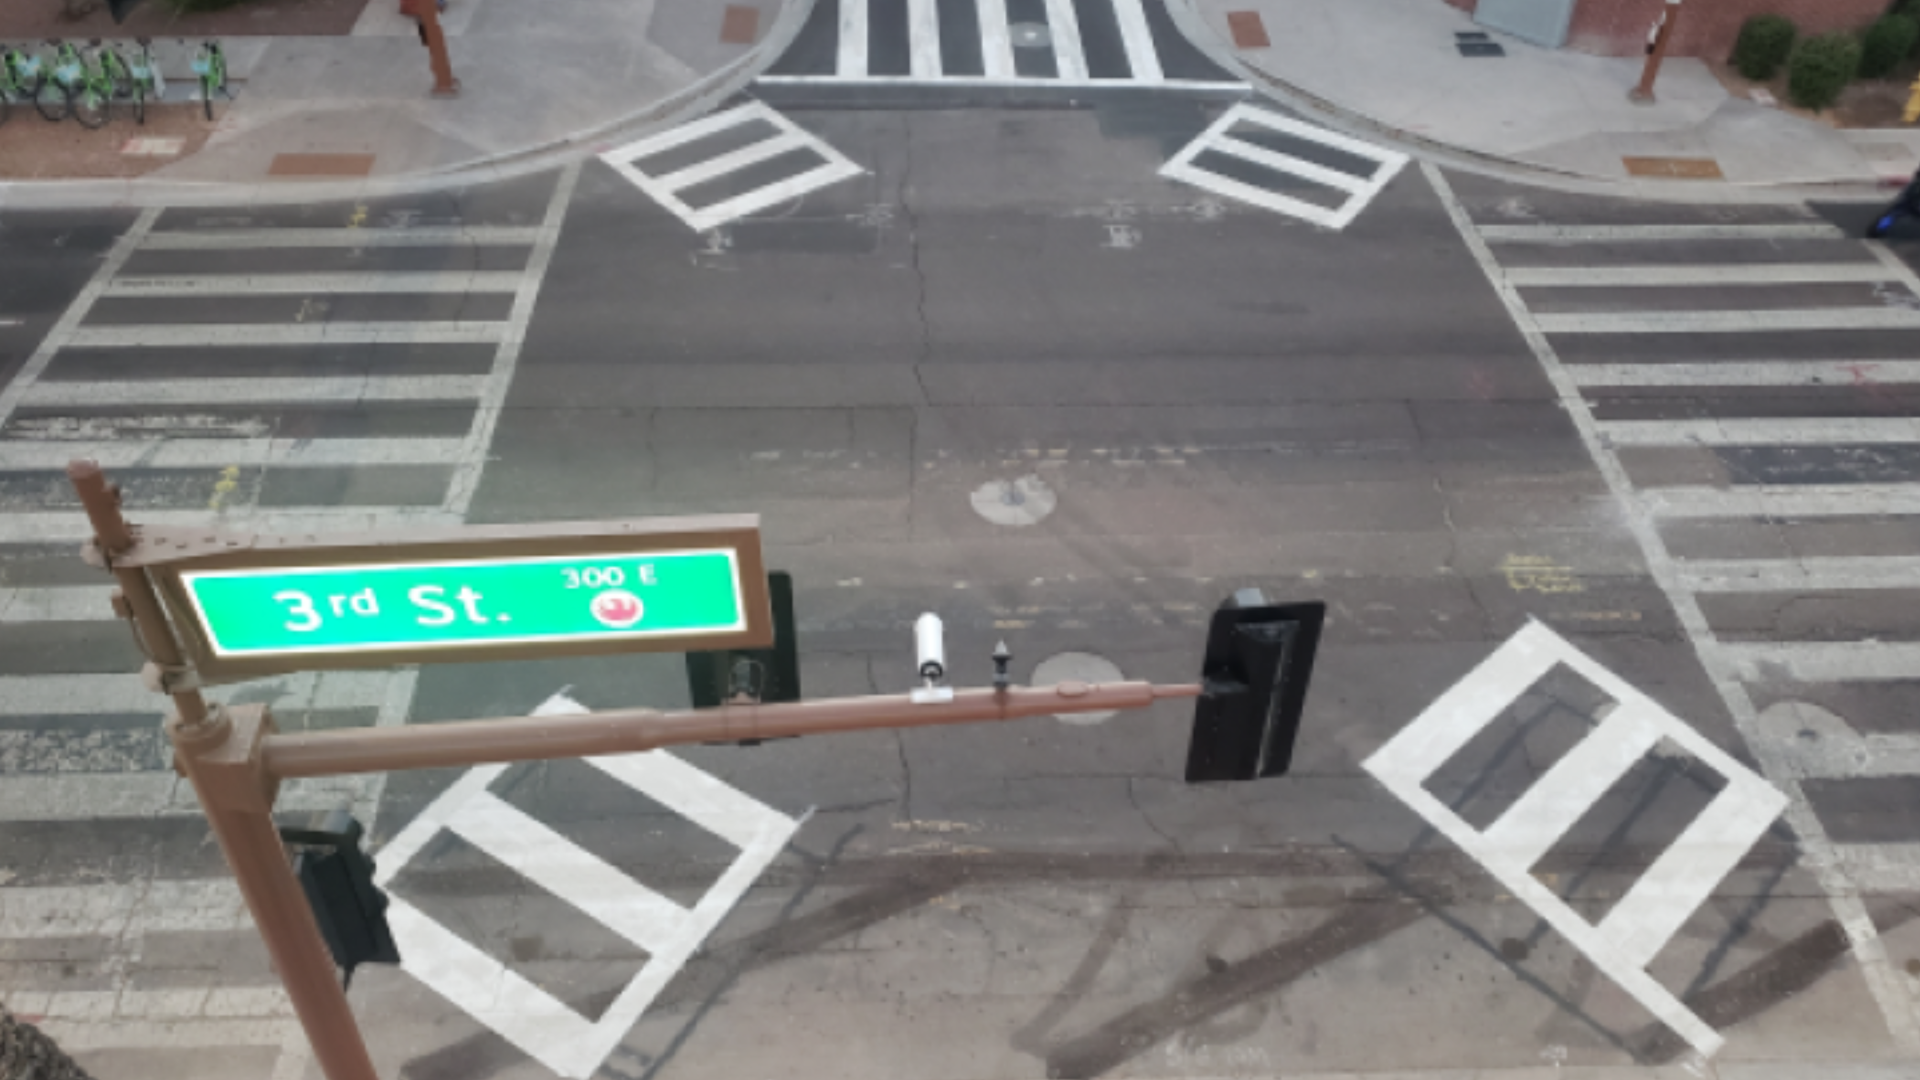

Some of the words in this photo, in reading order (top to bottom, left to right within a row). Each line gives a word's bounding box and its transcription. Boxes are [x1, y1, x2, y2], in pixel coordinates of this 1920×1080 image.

[561, 566, 625, 590] 300
[639, 563, 658, 586] E
[273, 588, 380, 632] 3rd
[408, 585, 511, 626] St.
